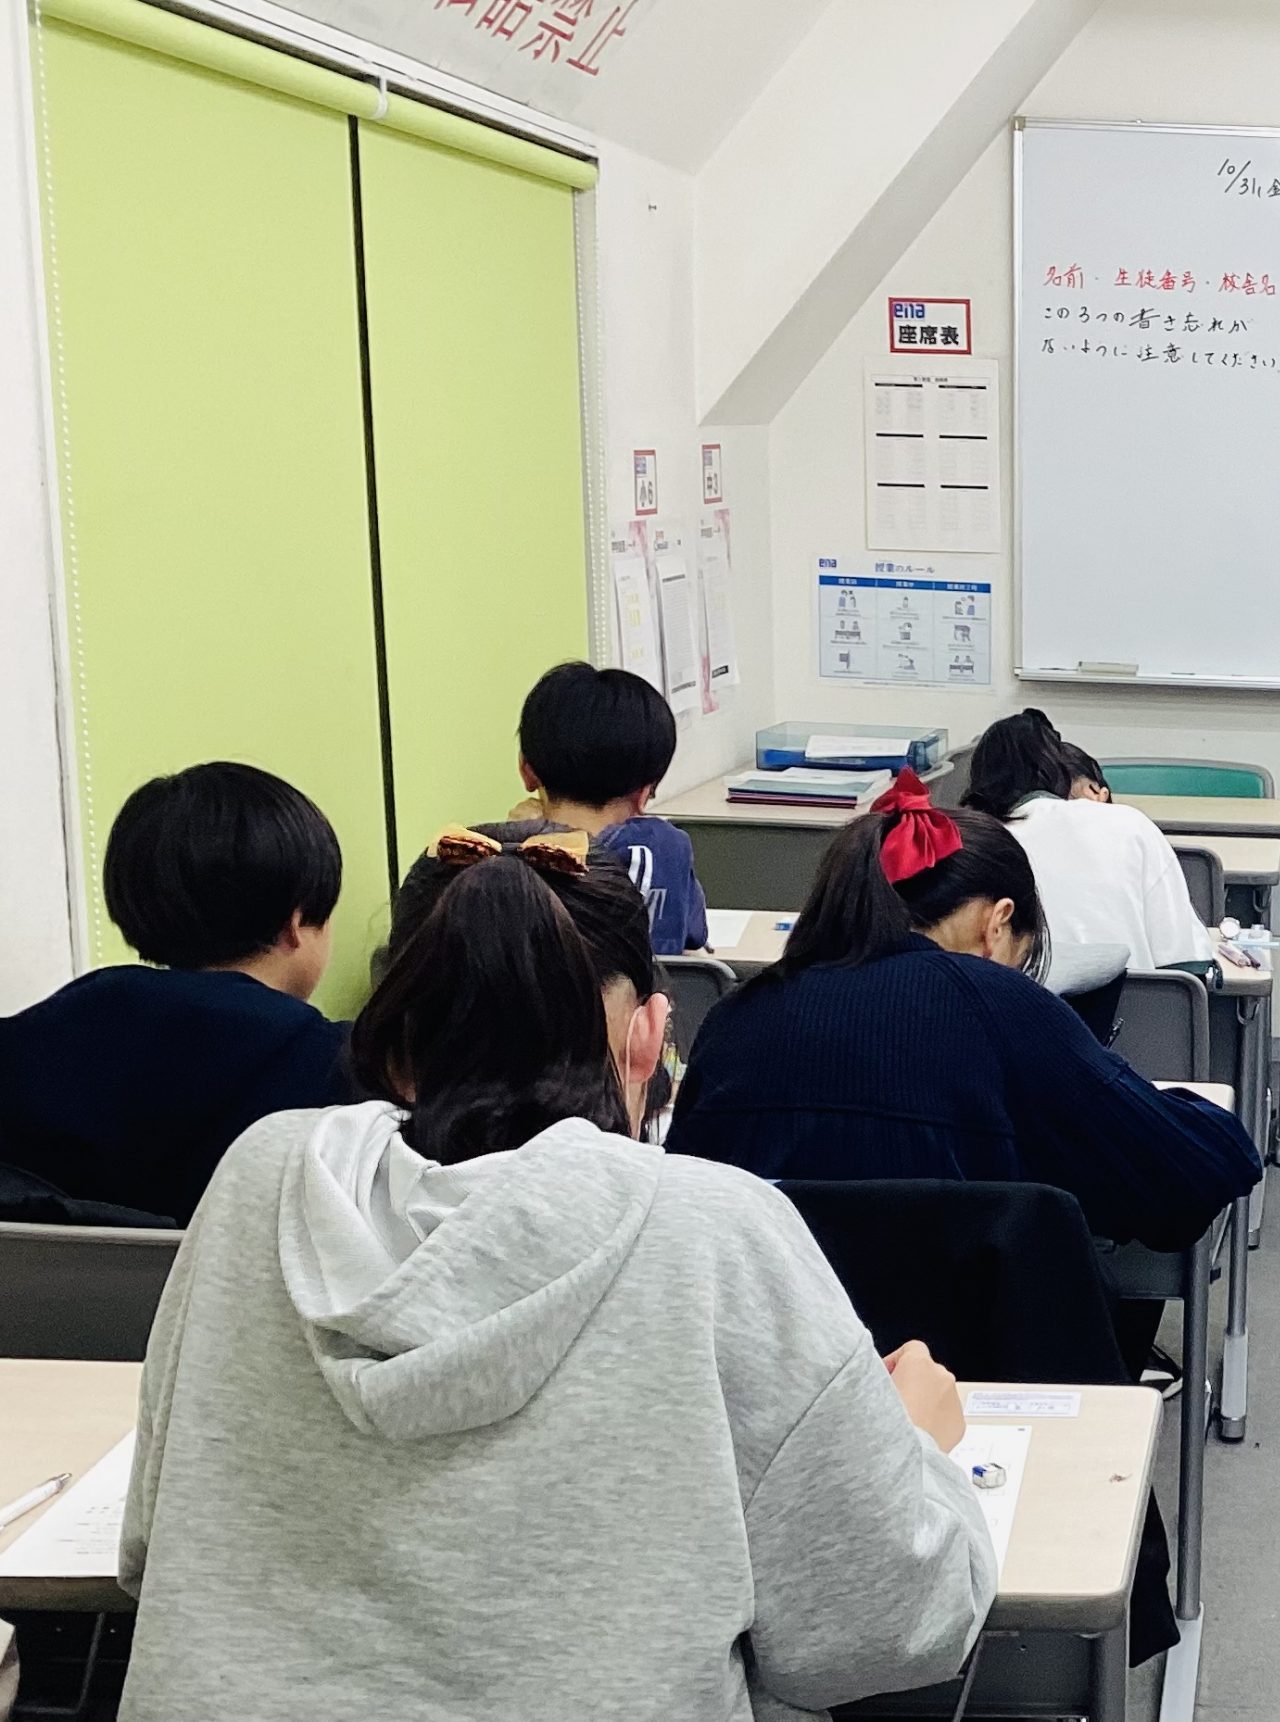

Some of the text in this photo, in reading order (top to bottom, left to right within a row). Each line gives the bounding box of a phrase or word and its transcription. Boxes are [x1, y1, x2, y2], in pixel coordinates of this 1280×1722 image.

[894, 303, 926, 319] ena
[898, 325, 960, 346] 座席表
